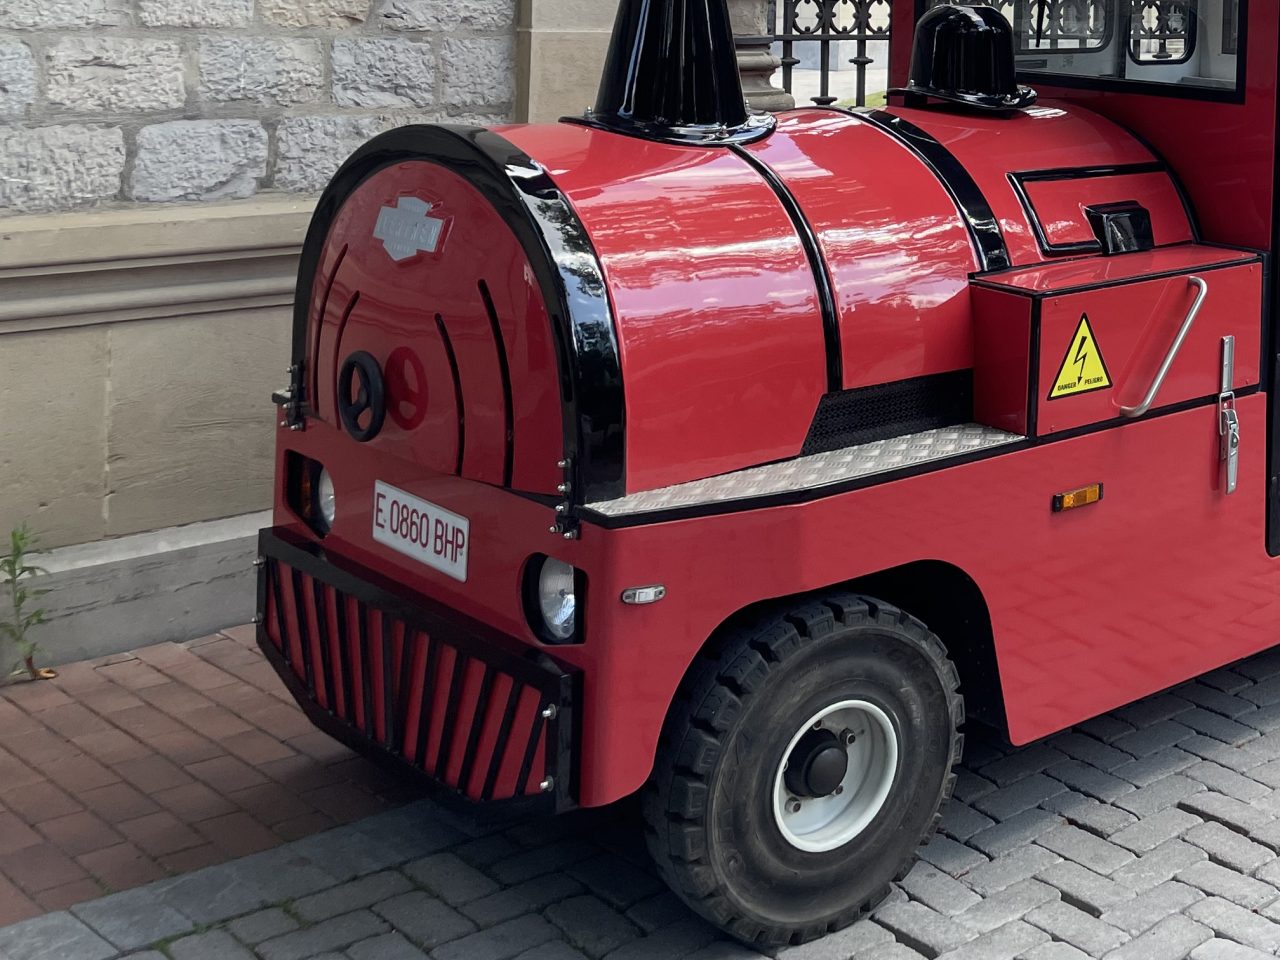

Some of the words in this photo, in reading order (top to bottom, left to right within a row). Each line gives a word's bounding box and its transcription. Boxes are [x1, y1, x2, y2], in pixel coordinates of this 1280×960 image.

[1057, 381, 1077, 392] DANGER
[1084, 376, 1104, 386] PELIGRO
[375, 492, 387, 529] E
[390, 500, 430, 549] 0860
[433, 518, 466, 564] BHP
